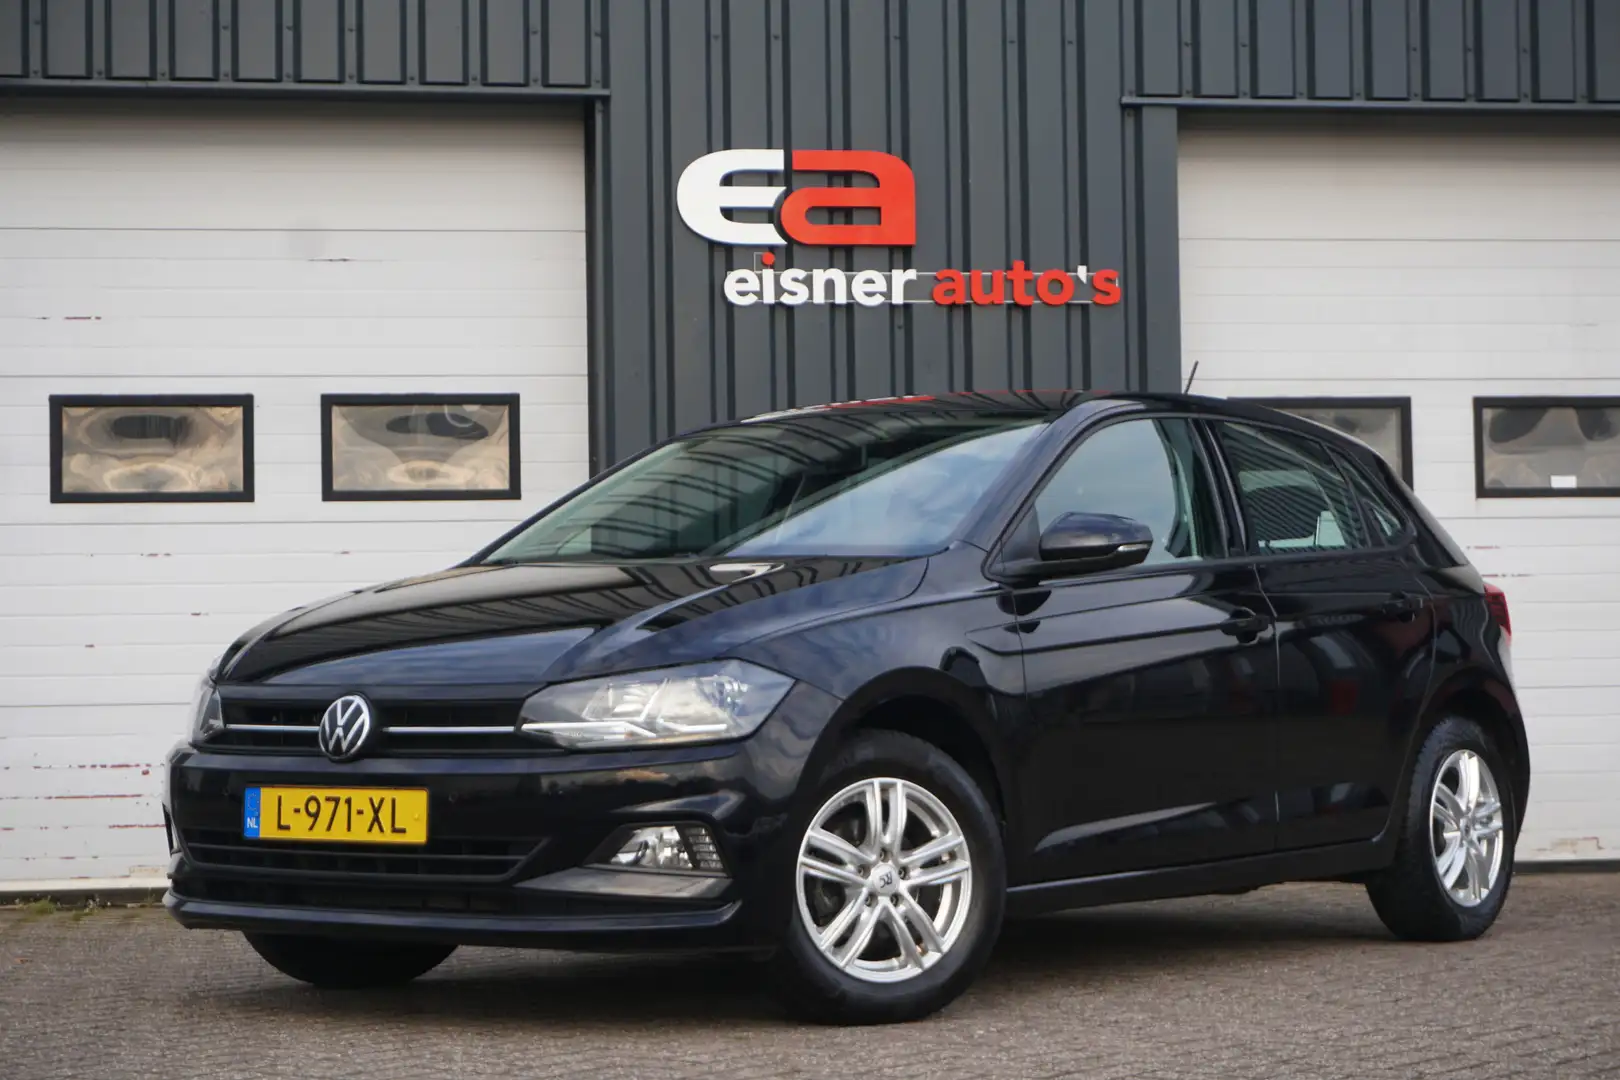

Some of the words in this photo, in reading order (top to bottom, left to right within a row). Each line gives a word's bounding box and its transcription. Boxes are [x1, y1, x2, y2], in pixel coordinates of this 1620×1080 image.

[724, 252, 917, 306] eisner
[932, 260, 1122, 306] auto's
[247, 816, 259, 829] NL
[276, 795, 407, 834] L-971-XL
